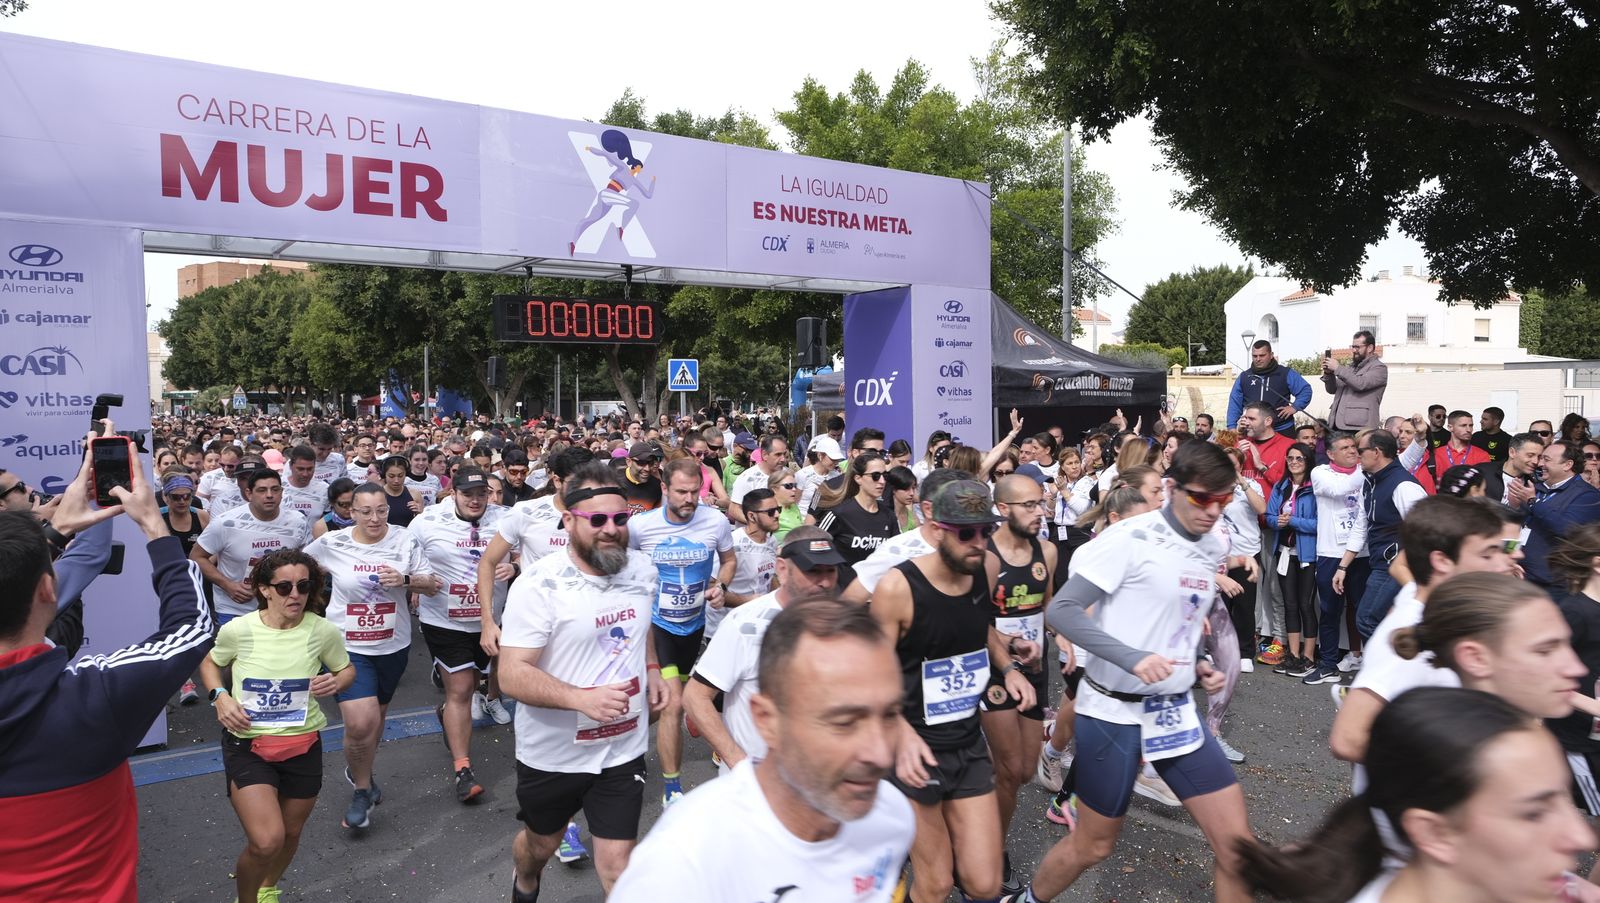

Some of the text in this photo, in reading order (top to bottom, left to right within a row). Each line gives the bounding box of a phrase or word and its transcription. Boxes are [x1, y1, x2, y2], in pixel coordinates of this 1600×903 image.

[177, 93, 432, 151] CARRERA DE LA
[159, 132, 448, 222] MUJER
[780, 174, 889, 205] LA IGUALDAD
[753, 201, 913, 235] ES NUESTRA META.
[762, 235, 791, 252] CDX
[820, 239, 850, 251] ALMERÍA
[0, 269, 84, 283] YUNDAI
[2, 283, 74, 295] Almerialva
[15, 310, 92, 327] cajamar
[527, 300, 653, 339] 00:00:00
[936, 314, 971, 323] HYUNDAI
[946, 337, 973, 348] cajamar
[0, 354, 67, 376] CASI
[939, 364, 964, 378] CASI
[854, 371, 899, 407] CDX
[947, 387, 973, 396] vithas
[25, 392, 94, 407] vithas
[943, 415, 972, 427] aqualia
[15, 440, 81, 460] aquali
[252, 540, 281, 549] MUJER
[456, 540, 488, 548] MUJER
[652, 549, 708, 560] PICO VELETA
[671, 594, 696, 606] 395
[357, 614, 385, 628] 654
[595, 607, 636, 629] MUJER
[940, 671, 977, 694] 352
[256, 692, 293, 707] 364
